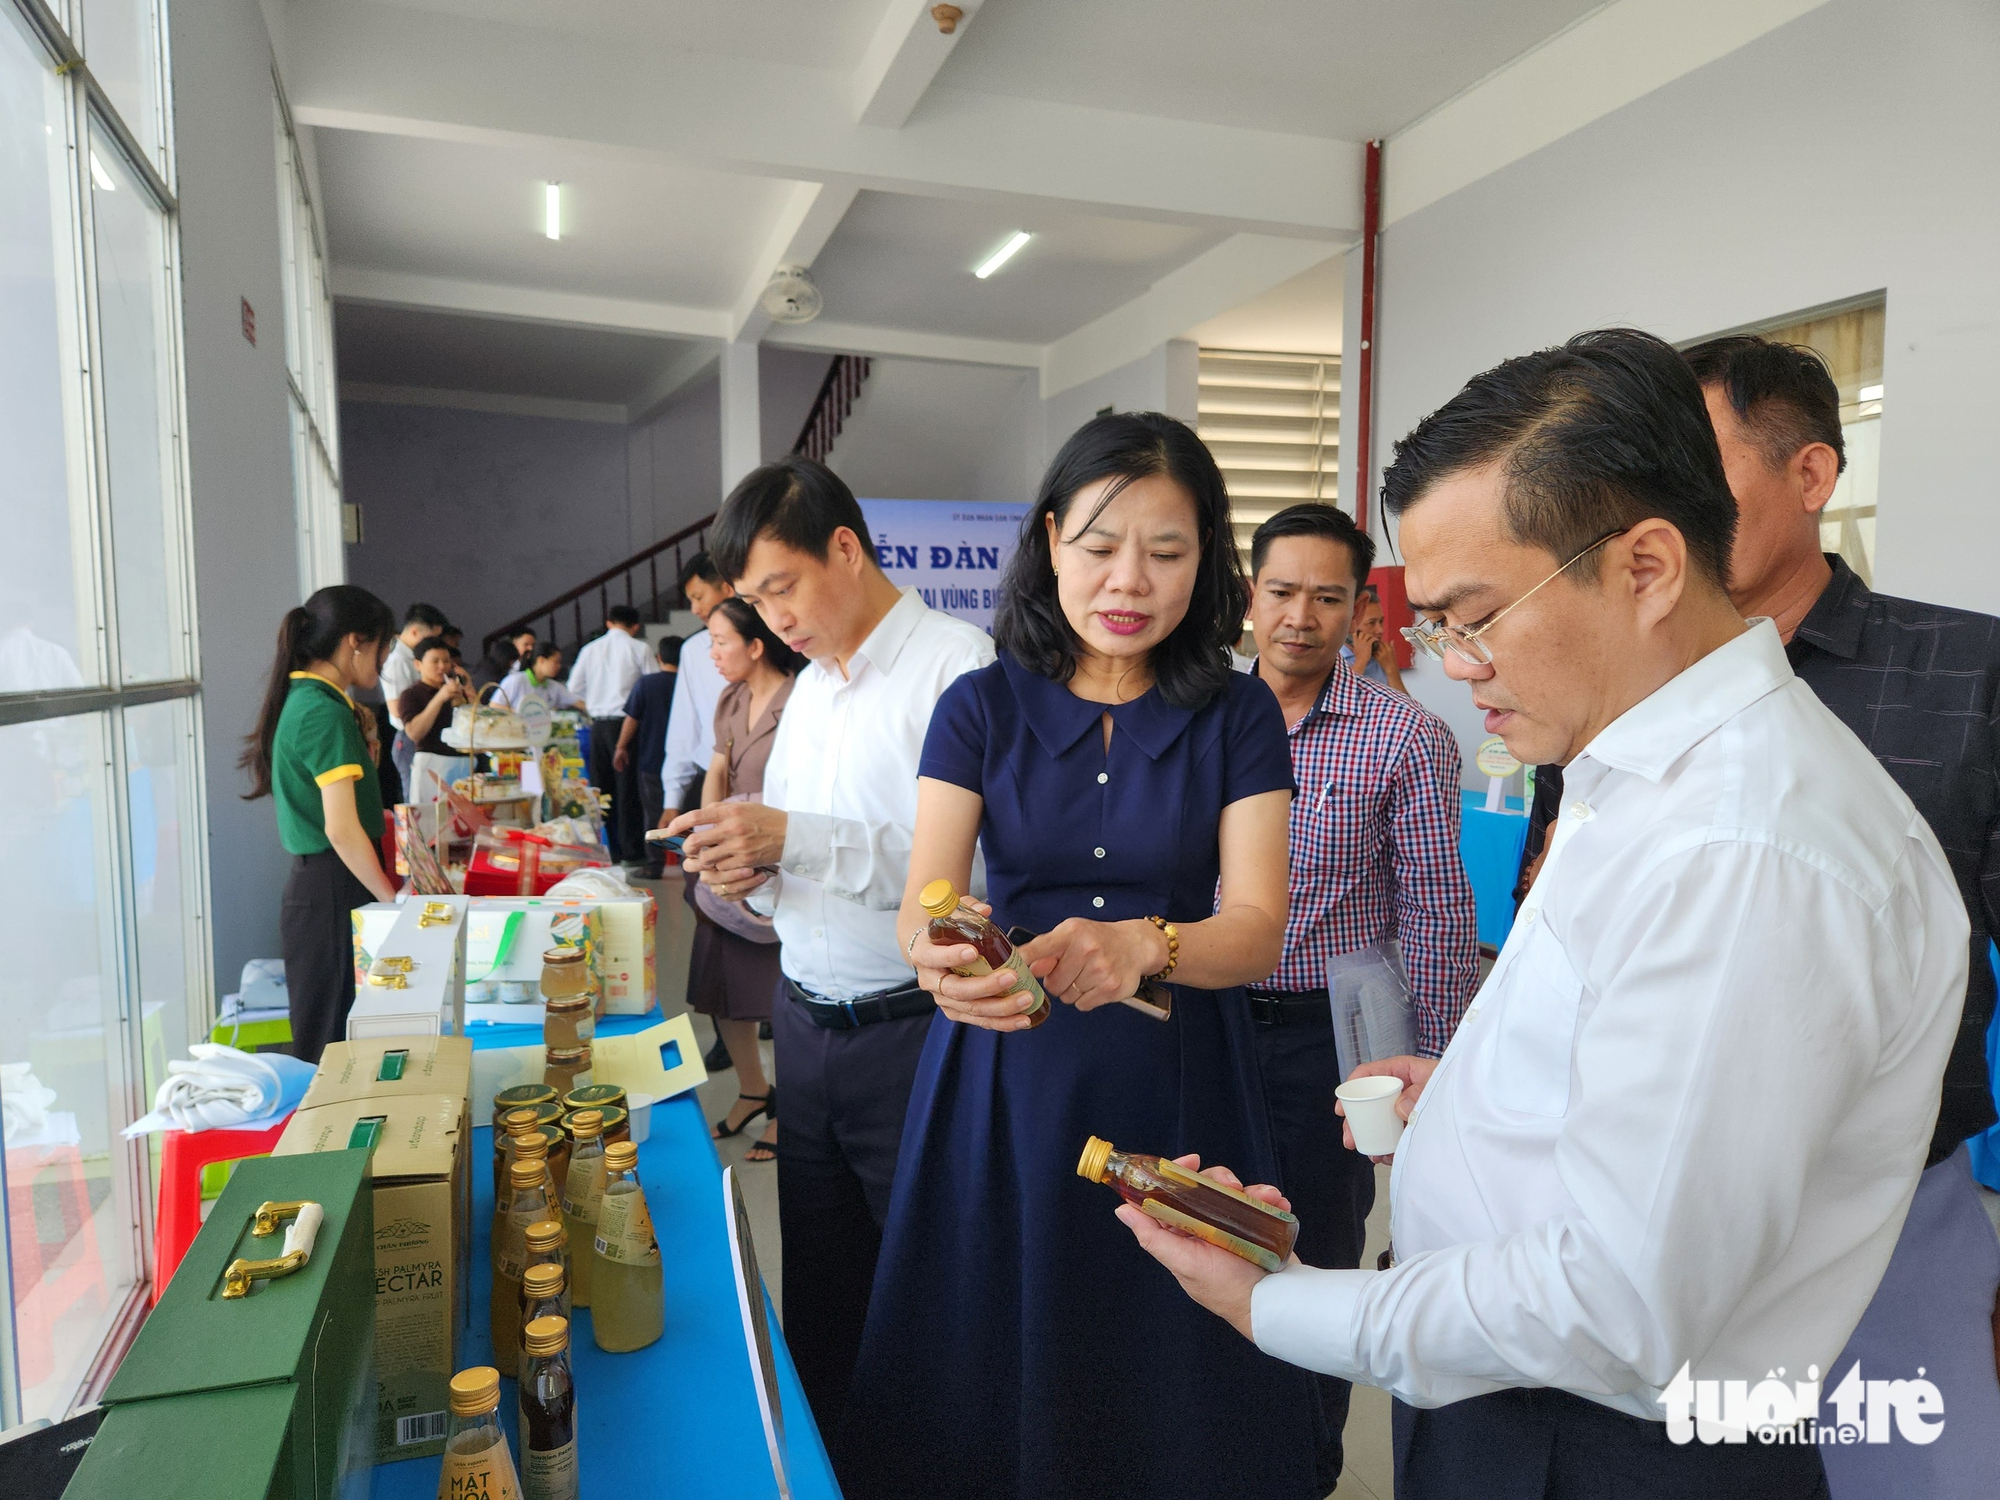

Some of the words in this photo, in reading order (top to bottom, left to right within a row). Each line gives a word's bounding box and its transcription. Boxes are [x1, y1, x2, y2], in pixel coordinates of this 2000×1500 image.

[930, 541, 999, 570] ĐÀN
[941, 584, 979, 609] VÙNG
[394, 1261, 442, 1274] PALMYRA
[452, 1471, 491, 1492] MẬT
